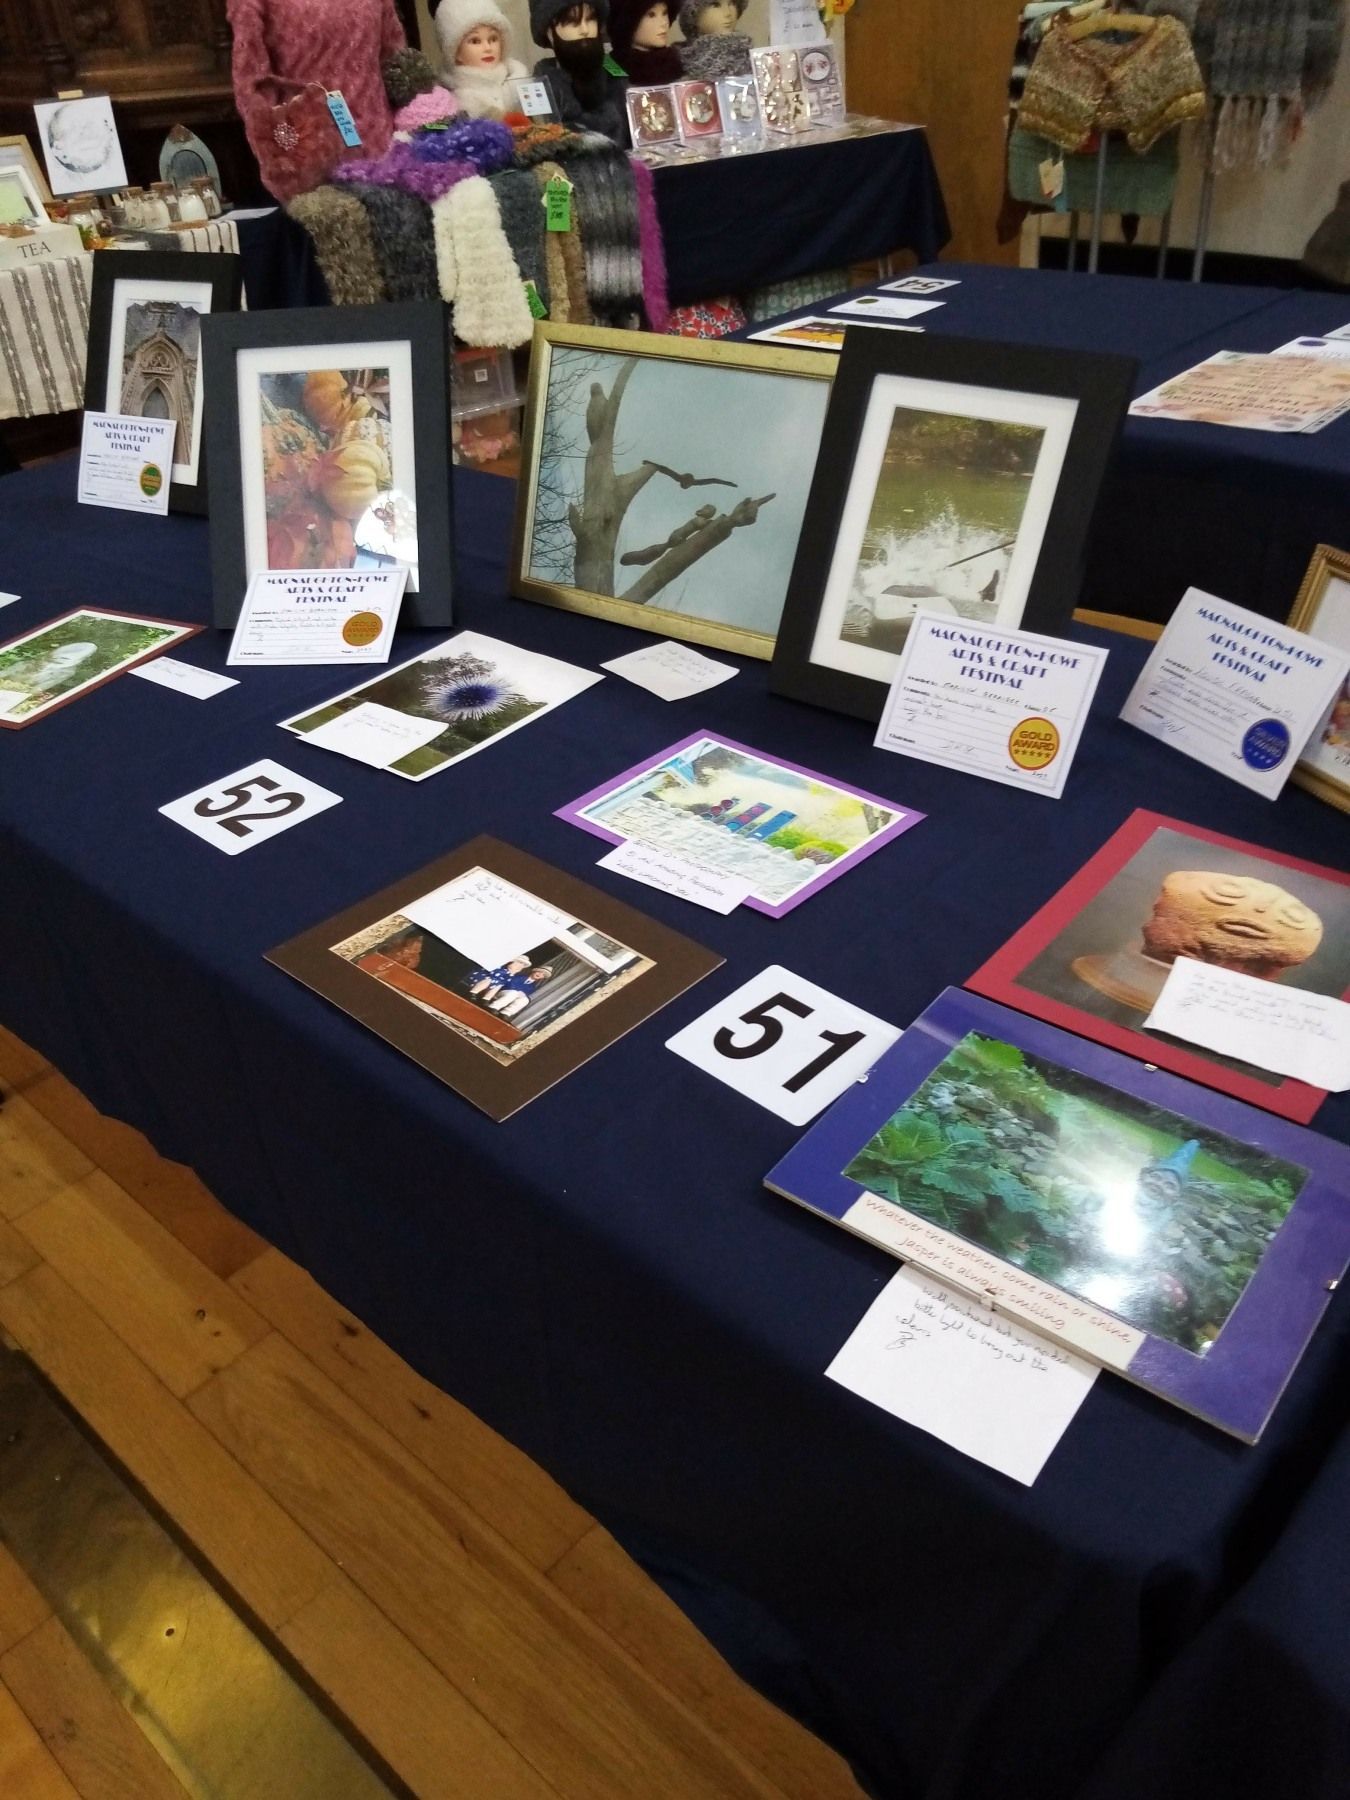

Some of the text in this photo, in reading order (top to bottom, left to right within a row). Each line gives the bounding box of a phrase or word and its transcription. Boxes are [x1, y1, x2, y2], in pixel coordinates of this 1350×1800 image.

[16, 241, 52, 258] TEA
[894, 279, 945, 291] 54
[949, 647, 1049, 679] ARTS & CRAFT
[1207, 632, 1238, 652] ARTS
[1251, 651, 1293, 675] CRAFT
[1212, 651, 1267, 683] FESTIVAL
[960, 665, 1024, 690] FESTIVAL
[1012, 739, 1055, 752] AWARD
[1019, 730, 1053, 742] GOLD
[194, 775, 306, 838] 52
[713, 991, 867, 1094] 51
[866, 1199, 923, 1232] Whatever
[926, 1229, 946, 1245] the
[947, 1241, 998, 1274] weather,
[1002, 1271, 1037, 1293] come
[1072, 1307, 1088, 1318] or
[942, 1256, 955, 1270] is
[1007, 1294, 1066, 1331] smiling
